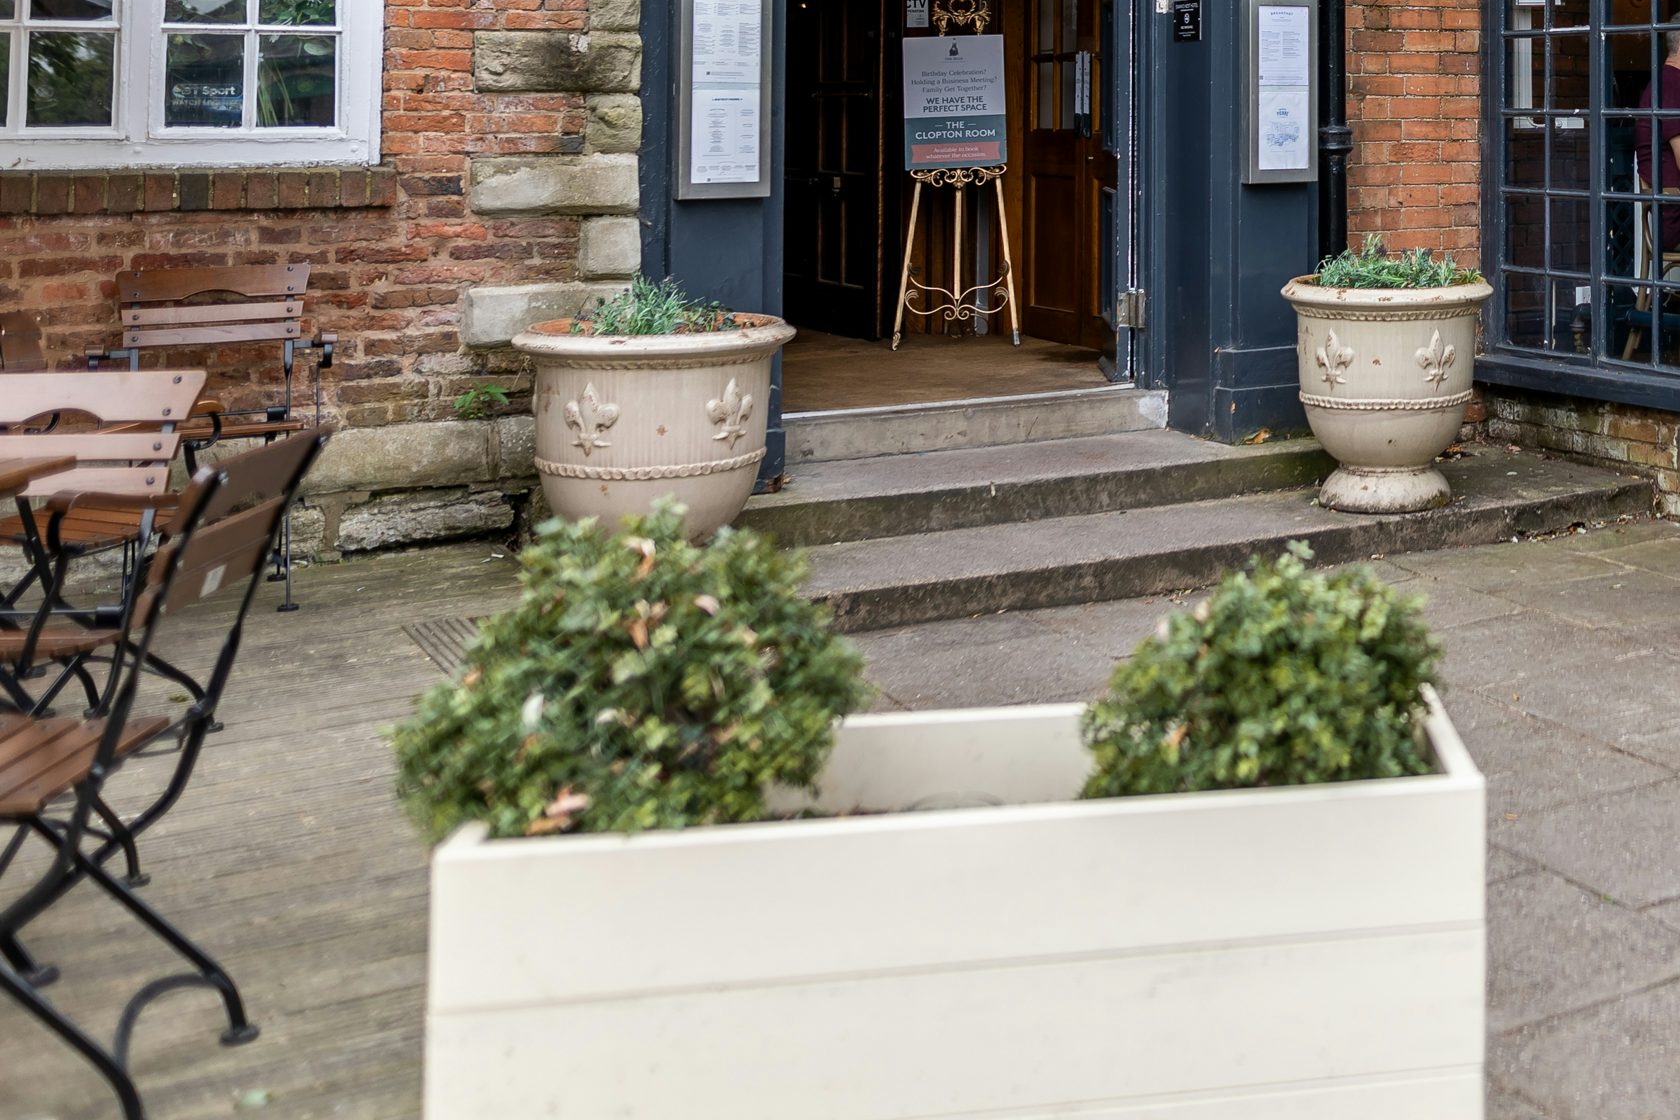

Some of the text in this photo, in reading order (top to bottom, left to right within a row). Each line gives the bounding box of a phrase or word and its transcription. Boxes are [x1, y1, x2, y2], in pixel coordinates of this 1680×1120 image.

[906, 0, 926, 9] CTV
[921, 70, 947, 78] Birthday
[202, 86, 236, 97] Sport
[926, 95, 984, 105] WE HAVE THE
[923, 103, 987, 113] PERFECT SPACE
[946, 121, 965, 129] THE
[915, 129, 996, 140] CLOPTON ROOM
